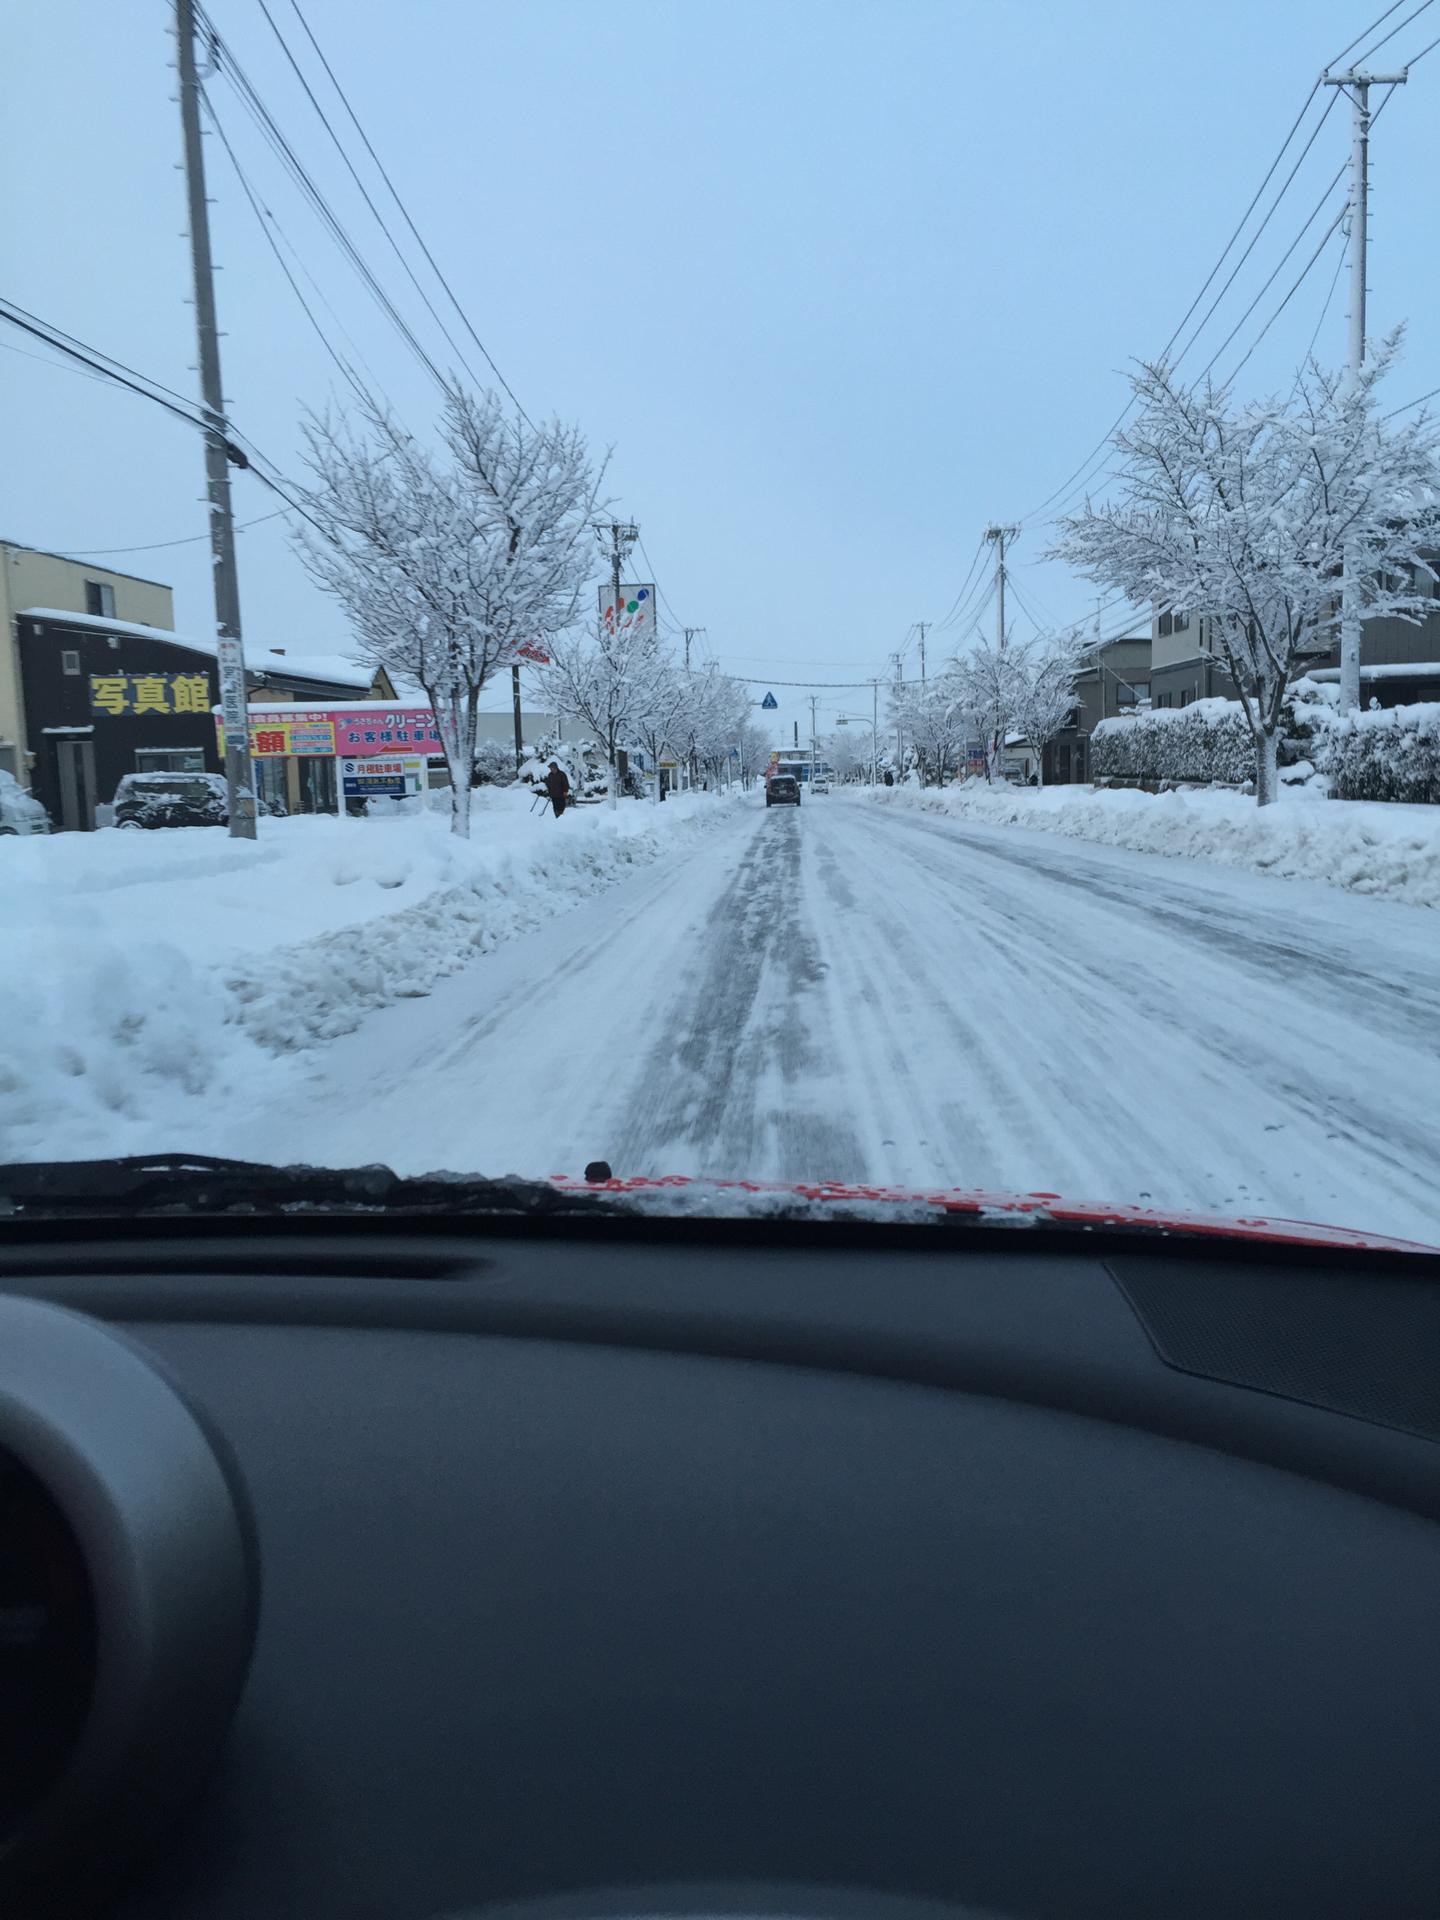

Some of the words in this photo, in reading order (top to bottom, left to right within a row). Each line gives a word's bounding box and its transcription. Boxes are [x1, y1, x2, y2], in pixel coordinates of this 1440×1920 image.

[91, 676, 209, 714] 写真館
[248, 713, 328, 723] 会員募集中!
